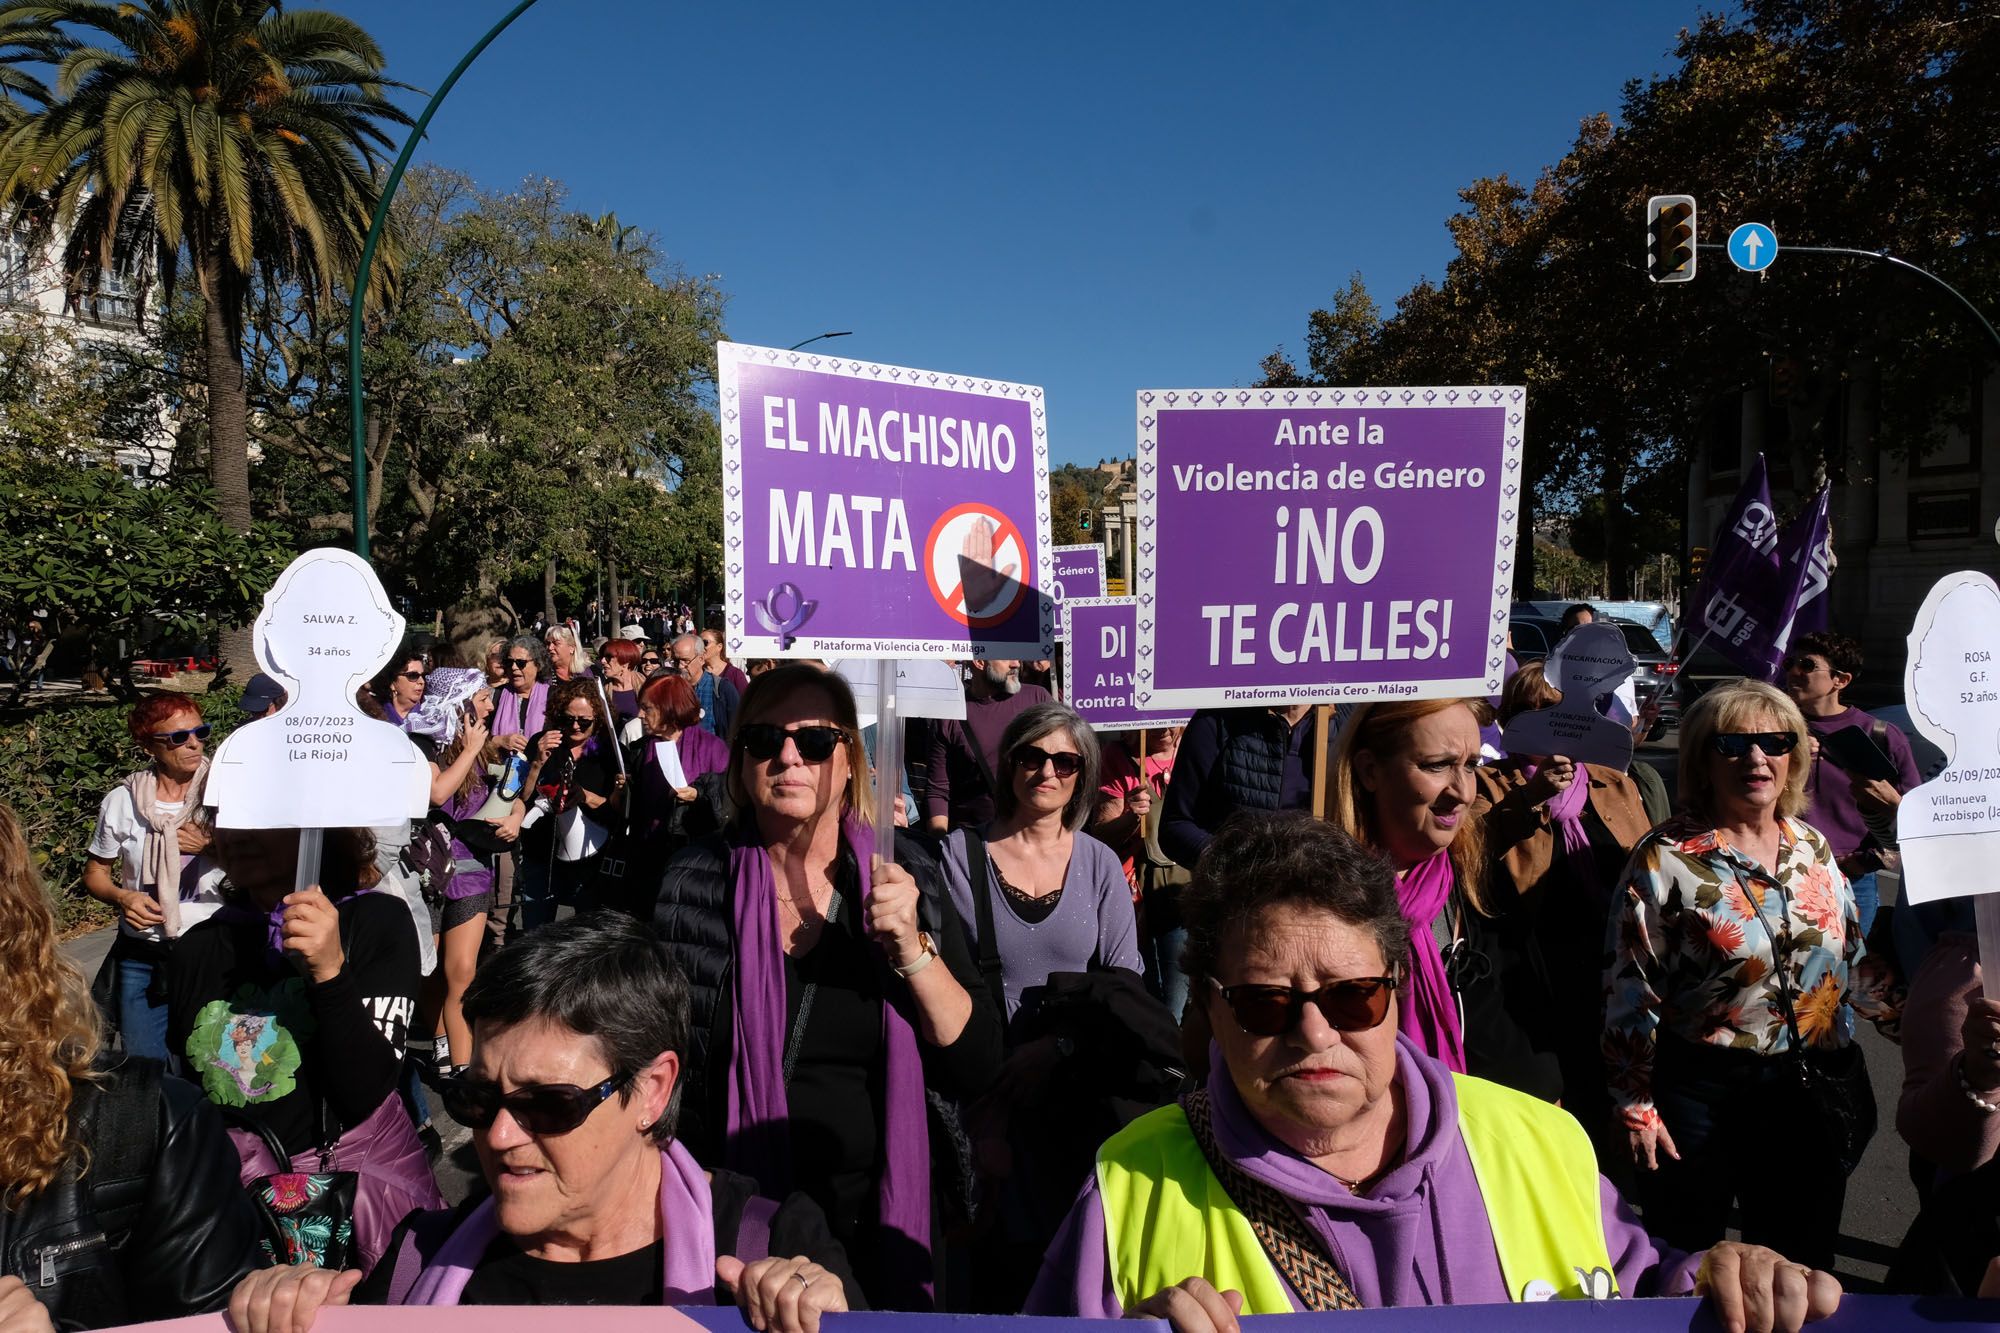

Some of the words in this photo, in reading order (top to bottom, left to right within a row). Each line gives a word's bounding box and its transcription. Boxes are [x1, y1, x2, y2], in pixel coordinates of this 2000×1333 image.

[764, 395, 809, 453] EL
[819, 402, 1017, 474] MACHISMO
[1274, 418, 1350, 446] Ante
[1358, 416, 1385, 446] la
[1172, 461, 1318, 492] Violencia
[1327, 461, 1366, 490] de
[1373, 461, 1486, 490] Género
[768, 488, 917, 572] MATA
[1274, 505, 1385, 585] ¡NO
[1058, 566, 1094, 575] Género
[303, 614, 344, 625] SALWA
[348, 615, 358, 625] Z.
[1201, 604, 1258, 667] TE
[1269, 598, 1453, 665] CALLES!
[307, 646, 321, 656] 34
[324, 647, 351, 657] años
[813, 640, 872, 652] Plataforma
[874, 642, 920, 653] Violencia
[922, 643, 944, 653] Cero
[951, 642, 986, 655] Málaga
[1964, 651, 1991, 663] ROSA
[1094, 674, 1106, 687] A
[1110, 672, 1124, 687] la
[1584, 675, 1602, 683] años
[1969, 672, 1989, 683] G.F.
[1224, 687, 1288, 700] Plataforma
[1289, 685, 1342, 698] Violencia
[1344, 685, 1369, 697] Cero
[1378, 682, 1418, 698] Málaga
[1960, 692, 1974, 703] 52
[1976, 690, 1998, 702] años
[1075, 694, 1126, 708] contra
[285, 716, 354, 728] 08/07/2023
[286, 732, 353, 744] LOGROÑO
[289, 749, 307, 762] (La
[311, 749, 348, 762] Rioja)
[1944, 767, 2000, 783] 05/09/202
[1931, 794, 1987, 807] Villanueva
[1932, 809, 1985, 823] Arzobispo
